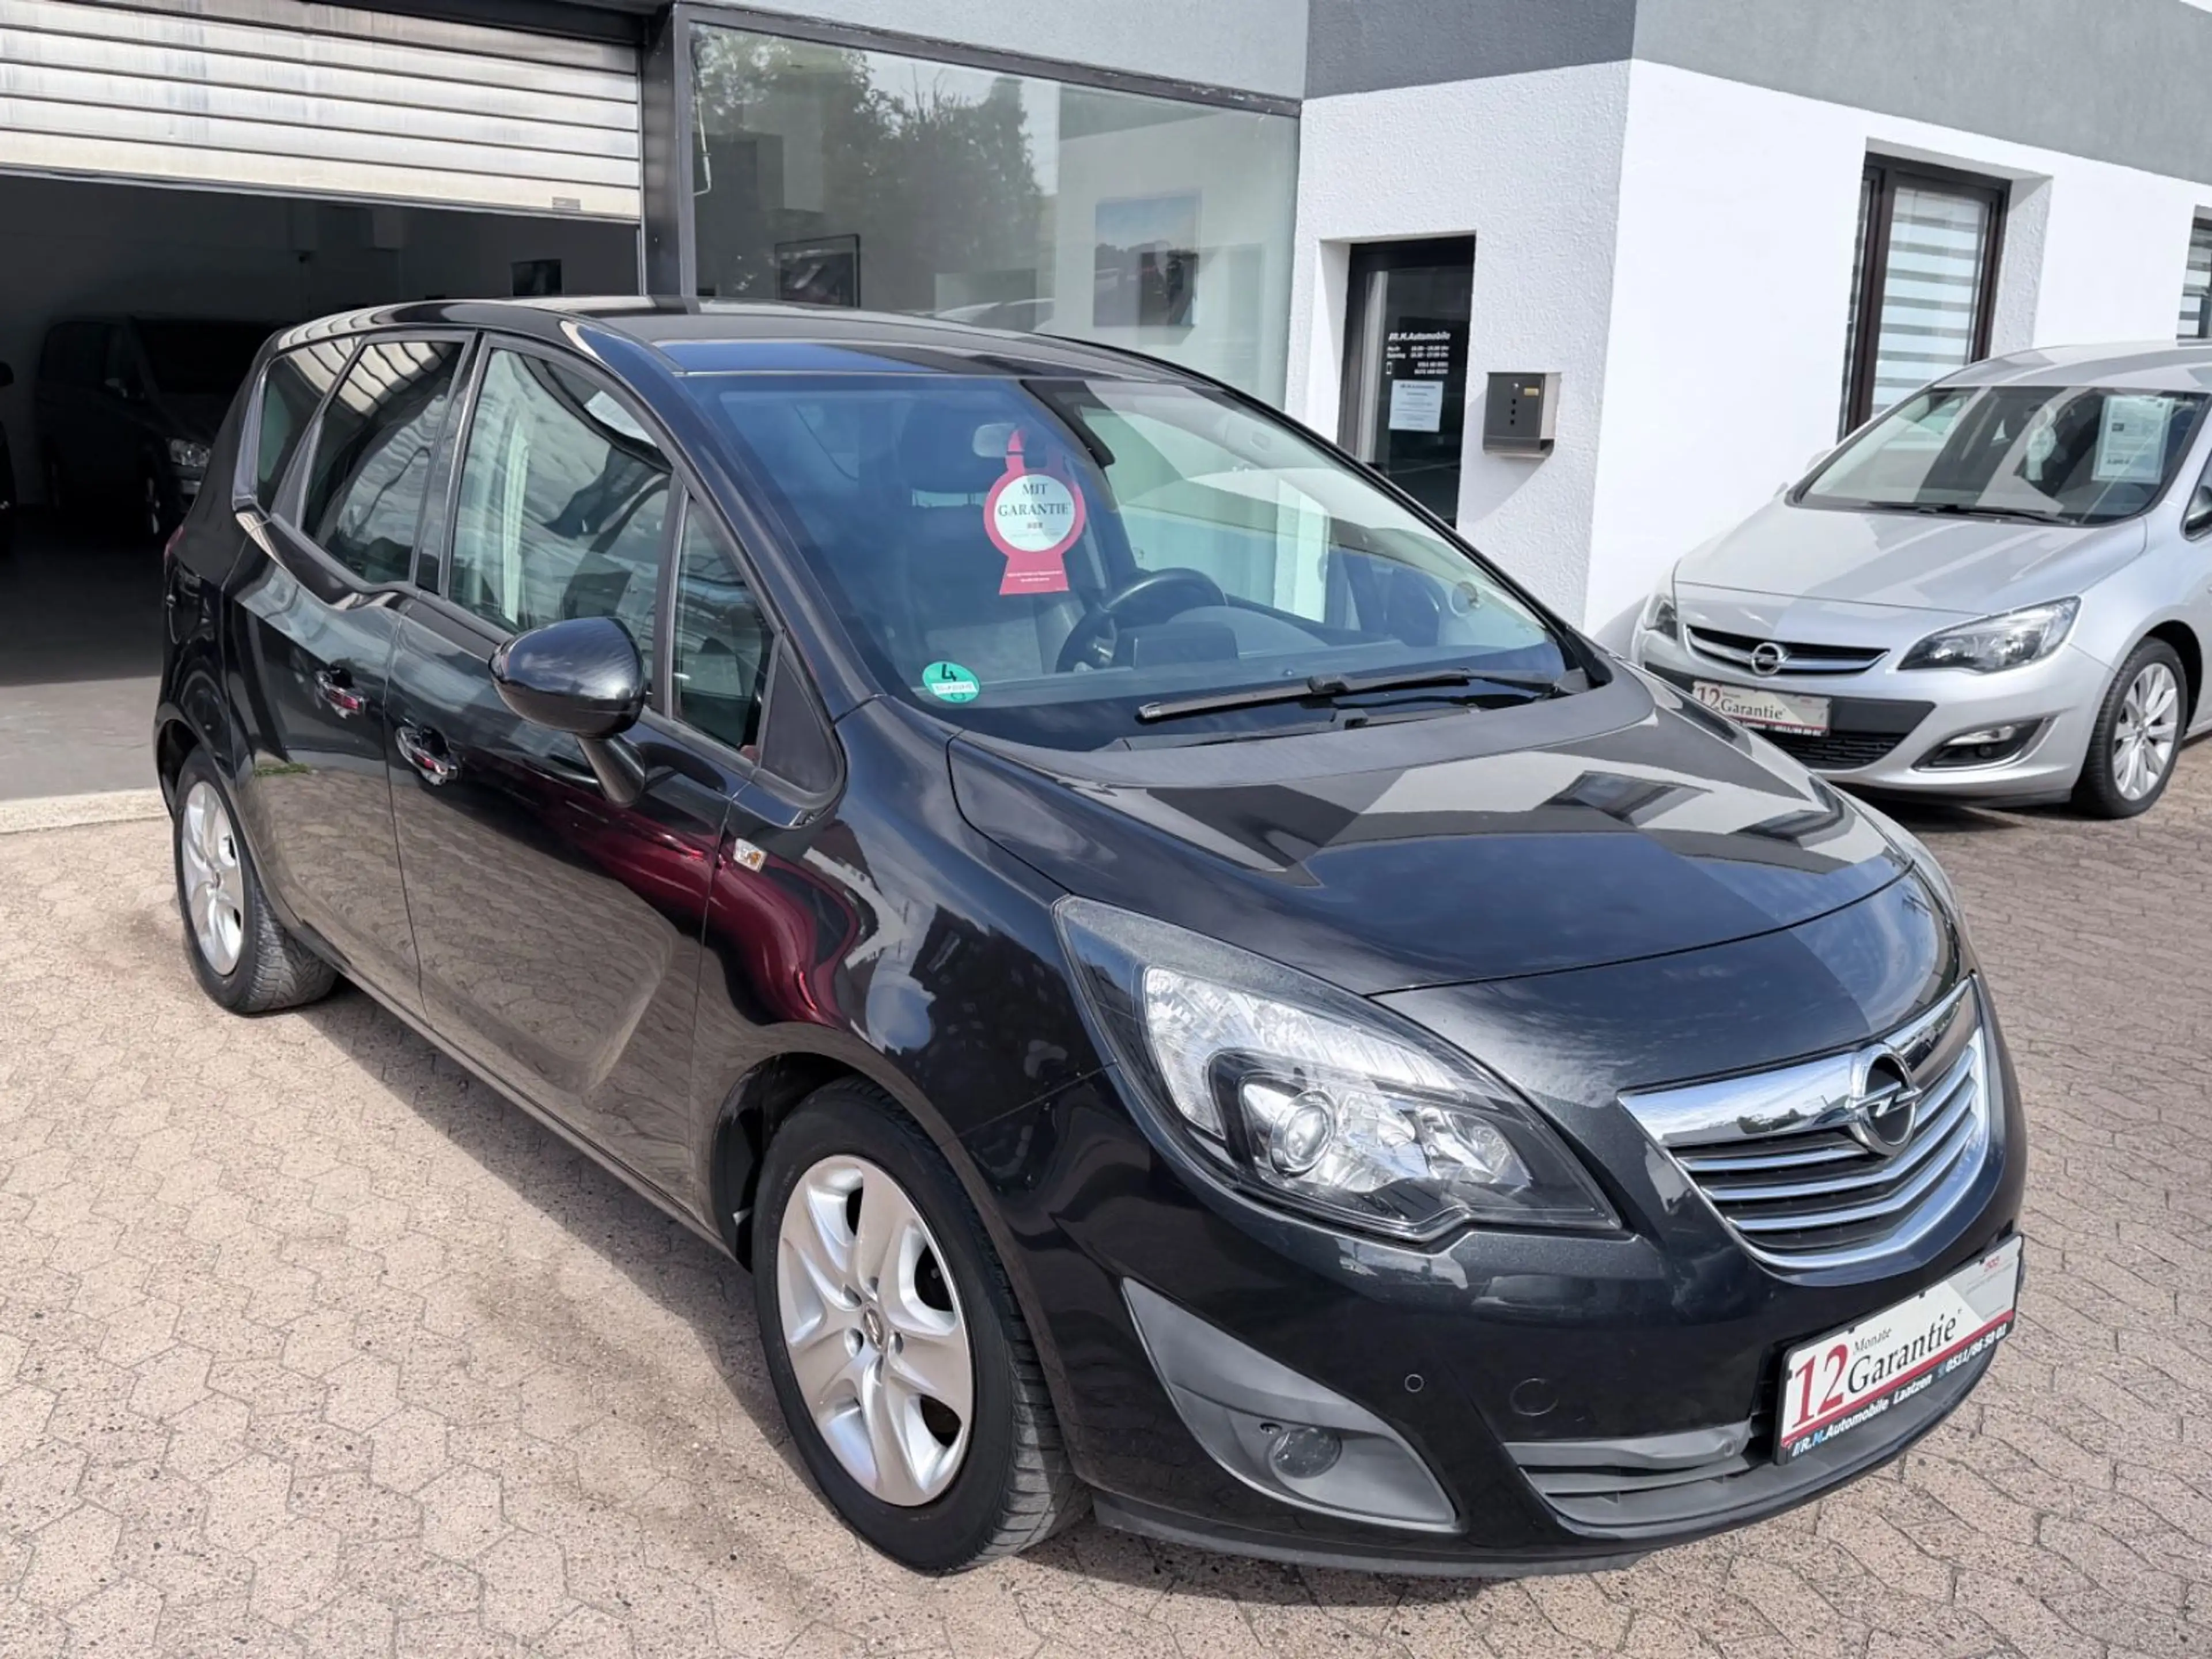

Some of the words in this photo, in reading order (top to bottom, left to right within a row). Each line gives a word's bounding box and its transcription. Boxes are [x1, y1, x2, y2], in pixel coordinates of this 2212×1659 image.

[1022, 483, 1048, 496] MIT
[998, 501, 1070, 517] GARANTIE
[941, 663, 957, 681] 4
[1697, 687, 1721, 710] 12
[1720, 697, 1783, 721] Garantie
[1853, 1327, 1892, 1354] Monate
[1791, 1343, 1849, 1429] 12
[1847, 1313, 1956, 1395] Garantie
